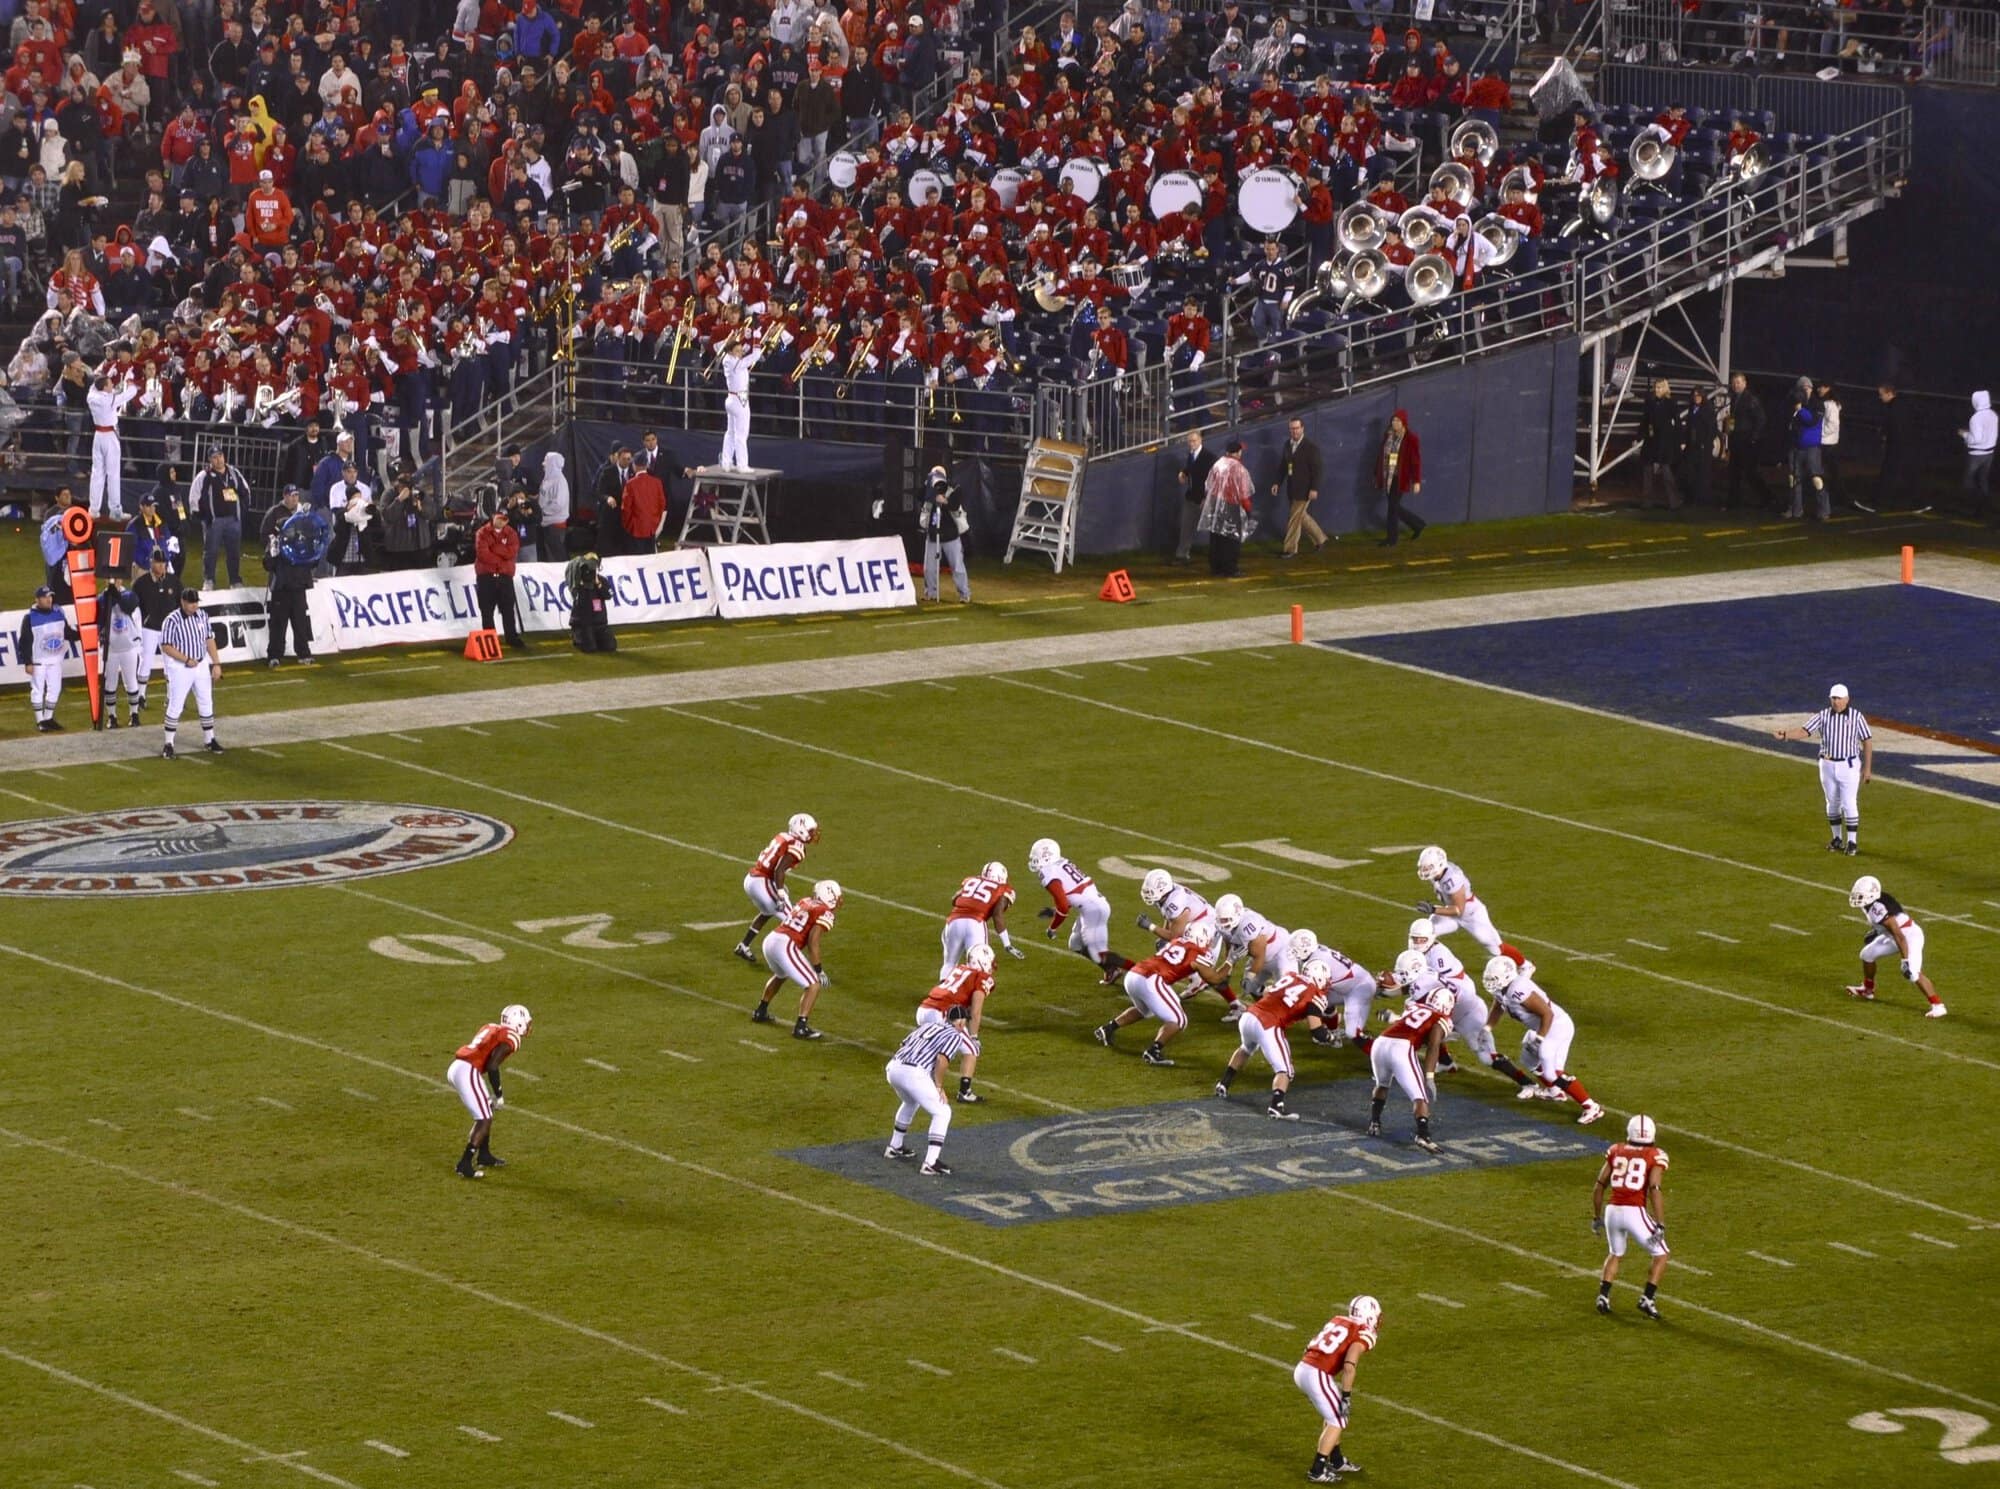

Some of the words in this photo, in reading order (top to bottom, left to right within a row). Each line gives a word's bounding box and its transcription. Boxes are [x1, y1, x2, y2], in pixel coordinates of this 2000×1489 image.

[108, 537, 121, 567] 1
[521, 573, 639, 612] PACIC
[637, 567, 708, 606] LIFE
[721, 562, 838, 602] PACIFIC
[837, 556, 905, 594] LIFE
[332, 586, 447, 628] PACIFIC
[445, 580, 480, 619] LI
[475, 633, 496, 659] 10
[961, 878, 998, 903] 95
[1243, 922, 1257, 935] 70
[939, 969, 973, 994] 51
[1267, 976, 1308, 1008] 94
[952, 1156, 1369, 1220] PACIFIC
[1610, 1156, 1648, 1191] 28
